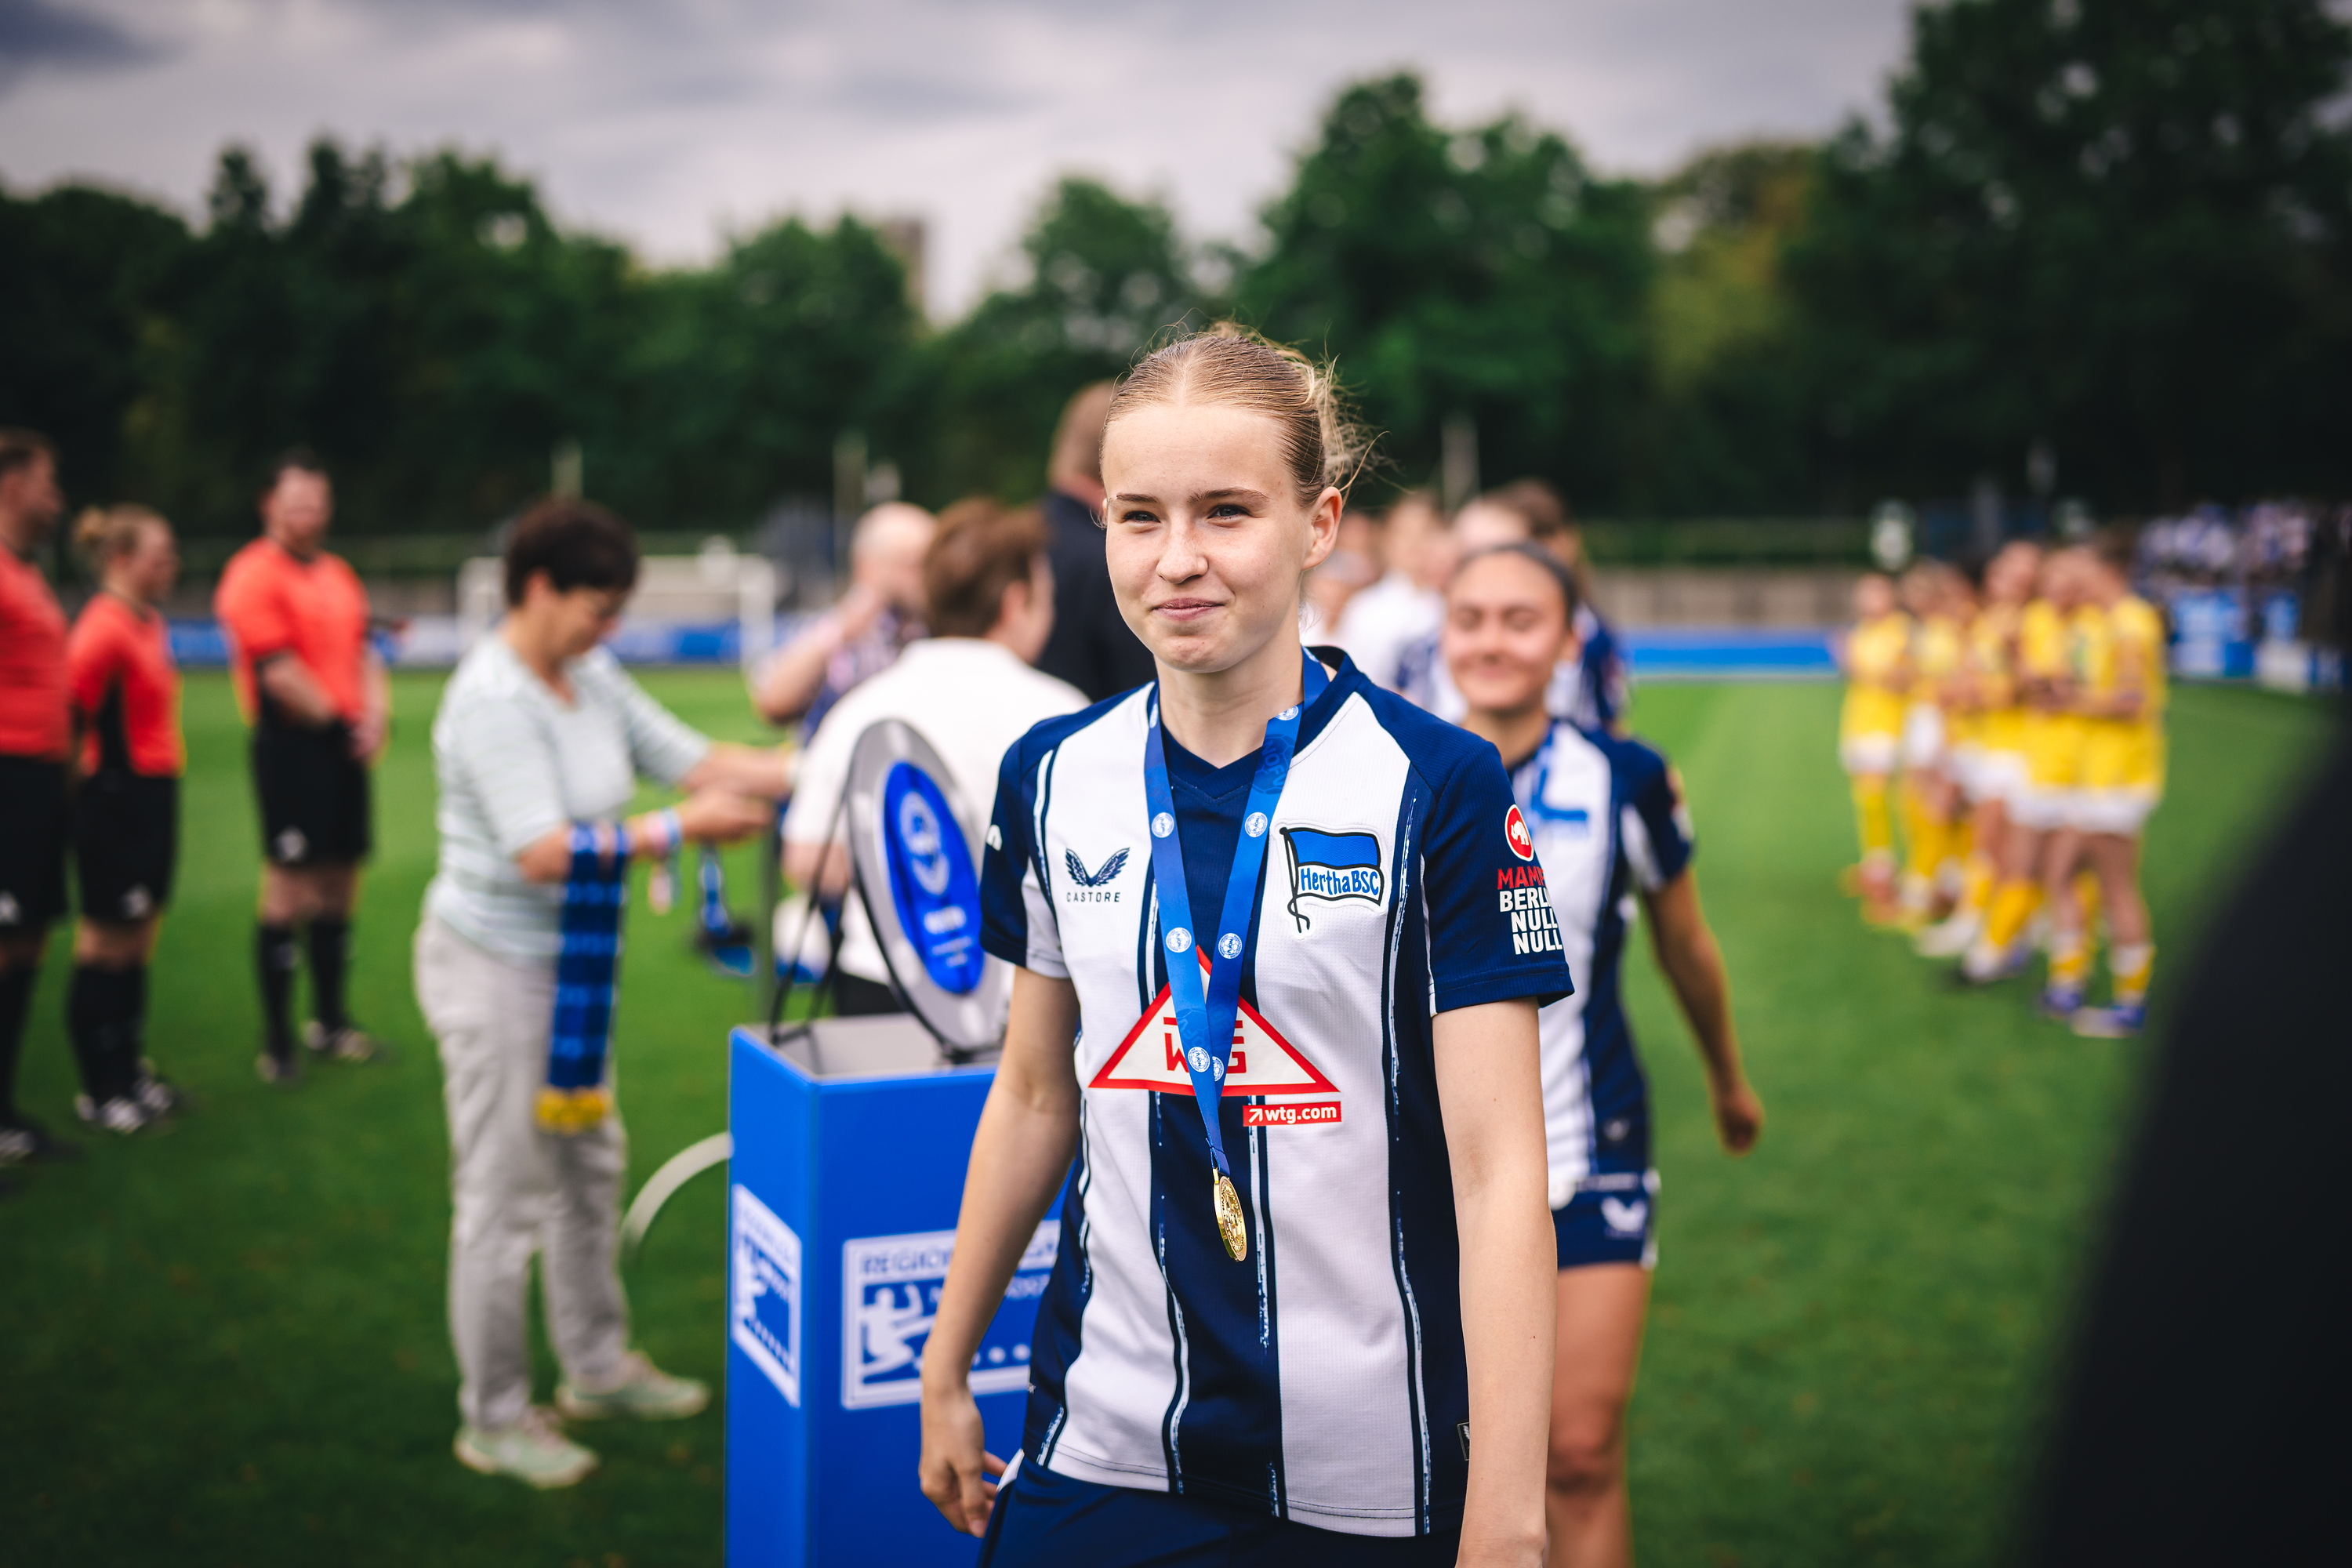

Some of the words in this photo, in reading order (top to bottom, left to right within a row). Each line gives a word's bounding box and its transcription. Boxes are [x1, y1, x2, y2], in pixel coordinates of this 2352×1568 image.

[1497, 866, 1547, 890] MAMP
[1066, 891, 1120, 902] CASTORE
[1499, 887, 1552, 912] BERLI
[1511, 908, 1558, 933] NULL
[1512, 929, 1563, 955] NULL
[1163, 1017, 1247, 1074] WG
[1265, 1106, 1337, 1124] wtg.com
